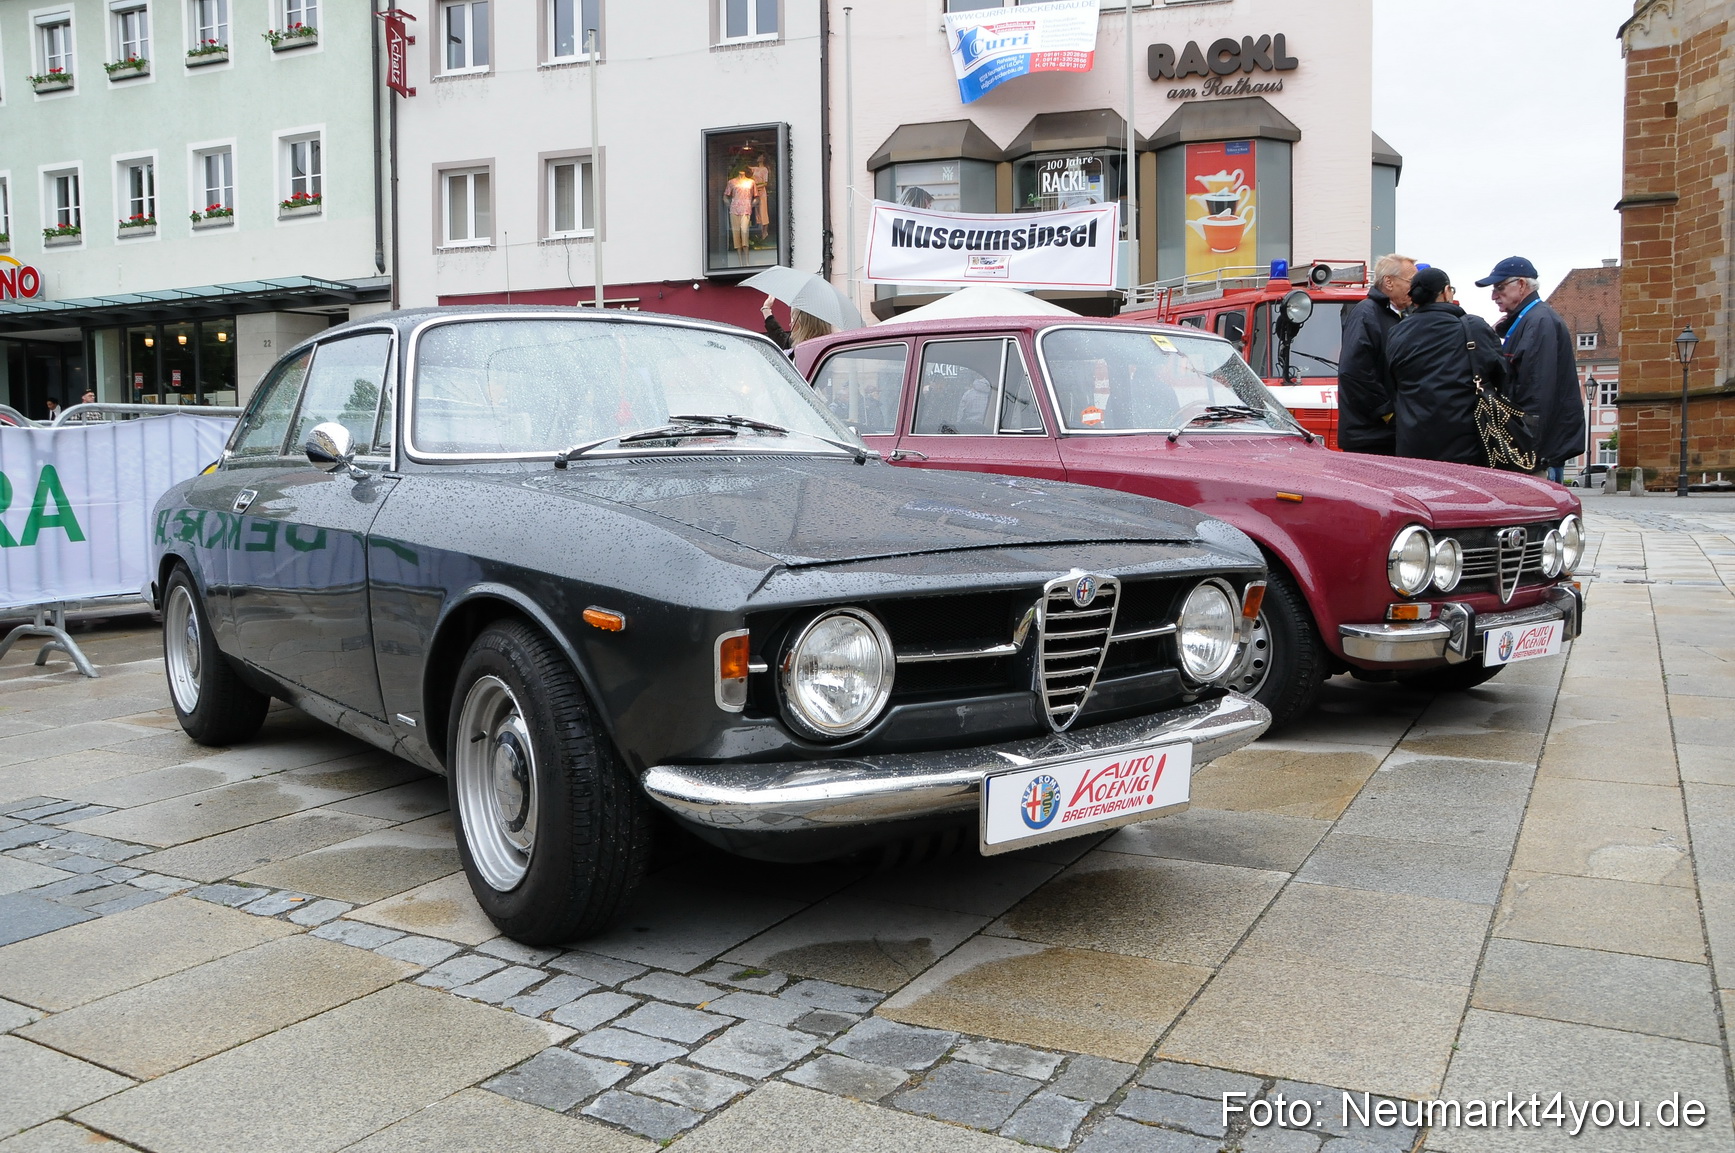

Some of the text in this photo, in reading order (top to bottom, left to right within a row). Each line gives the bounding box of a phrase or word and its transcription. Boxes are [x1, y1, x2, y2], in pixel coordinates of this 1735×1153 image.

[390, 27, 402, 85] Achatz
[970, 33, 1029, 58] Curri
[1148, 33, 1299, 81] RACKL
[1167, 76, 1284, 99] am Rathaus
[1046, 156, 1094, 171] 100 Jahre
[891, 218, 1098, 251] Museumsinsel
[263, 339, 272, 348] 22
[1529, 625, 1550, 638] AUTO
[1103, 755, 1155, 779] AUTO
[1021, 775, 1062, 809] ALFA ROMEO
[1061, 796, 1144, 823] BREITENBRUNN
